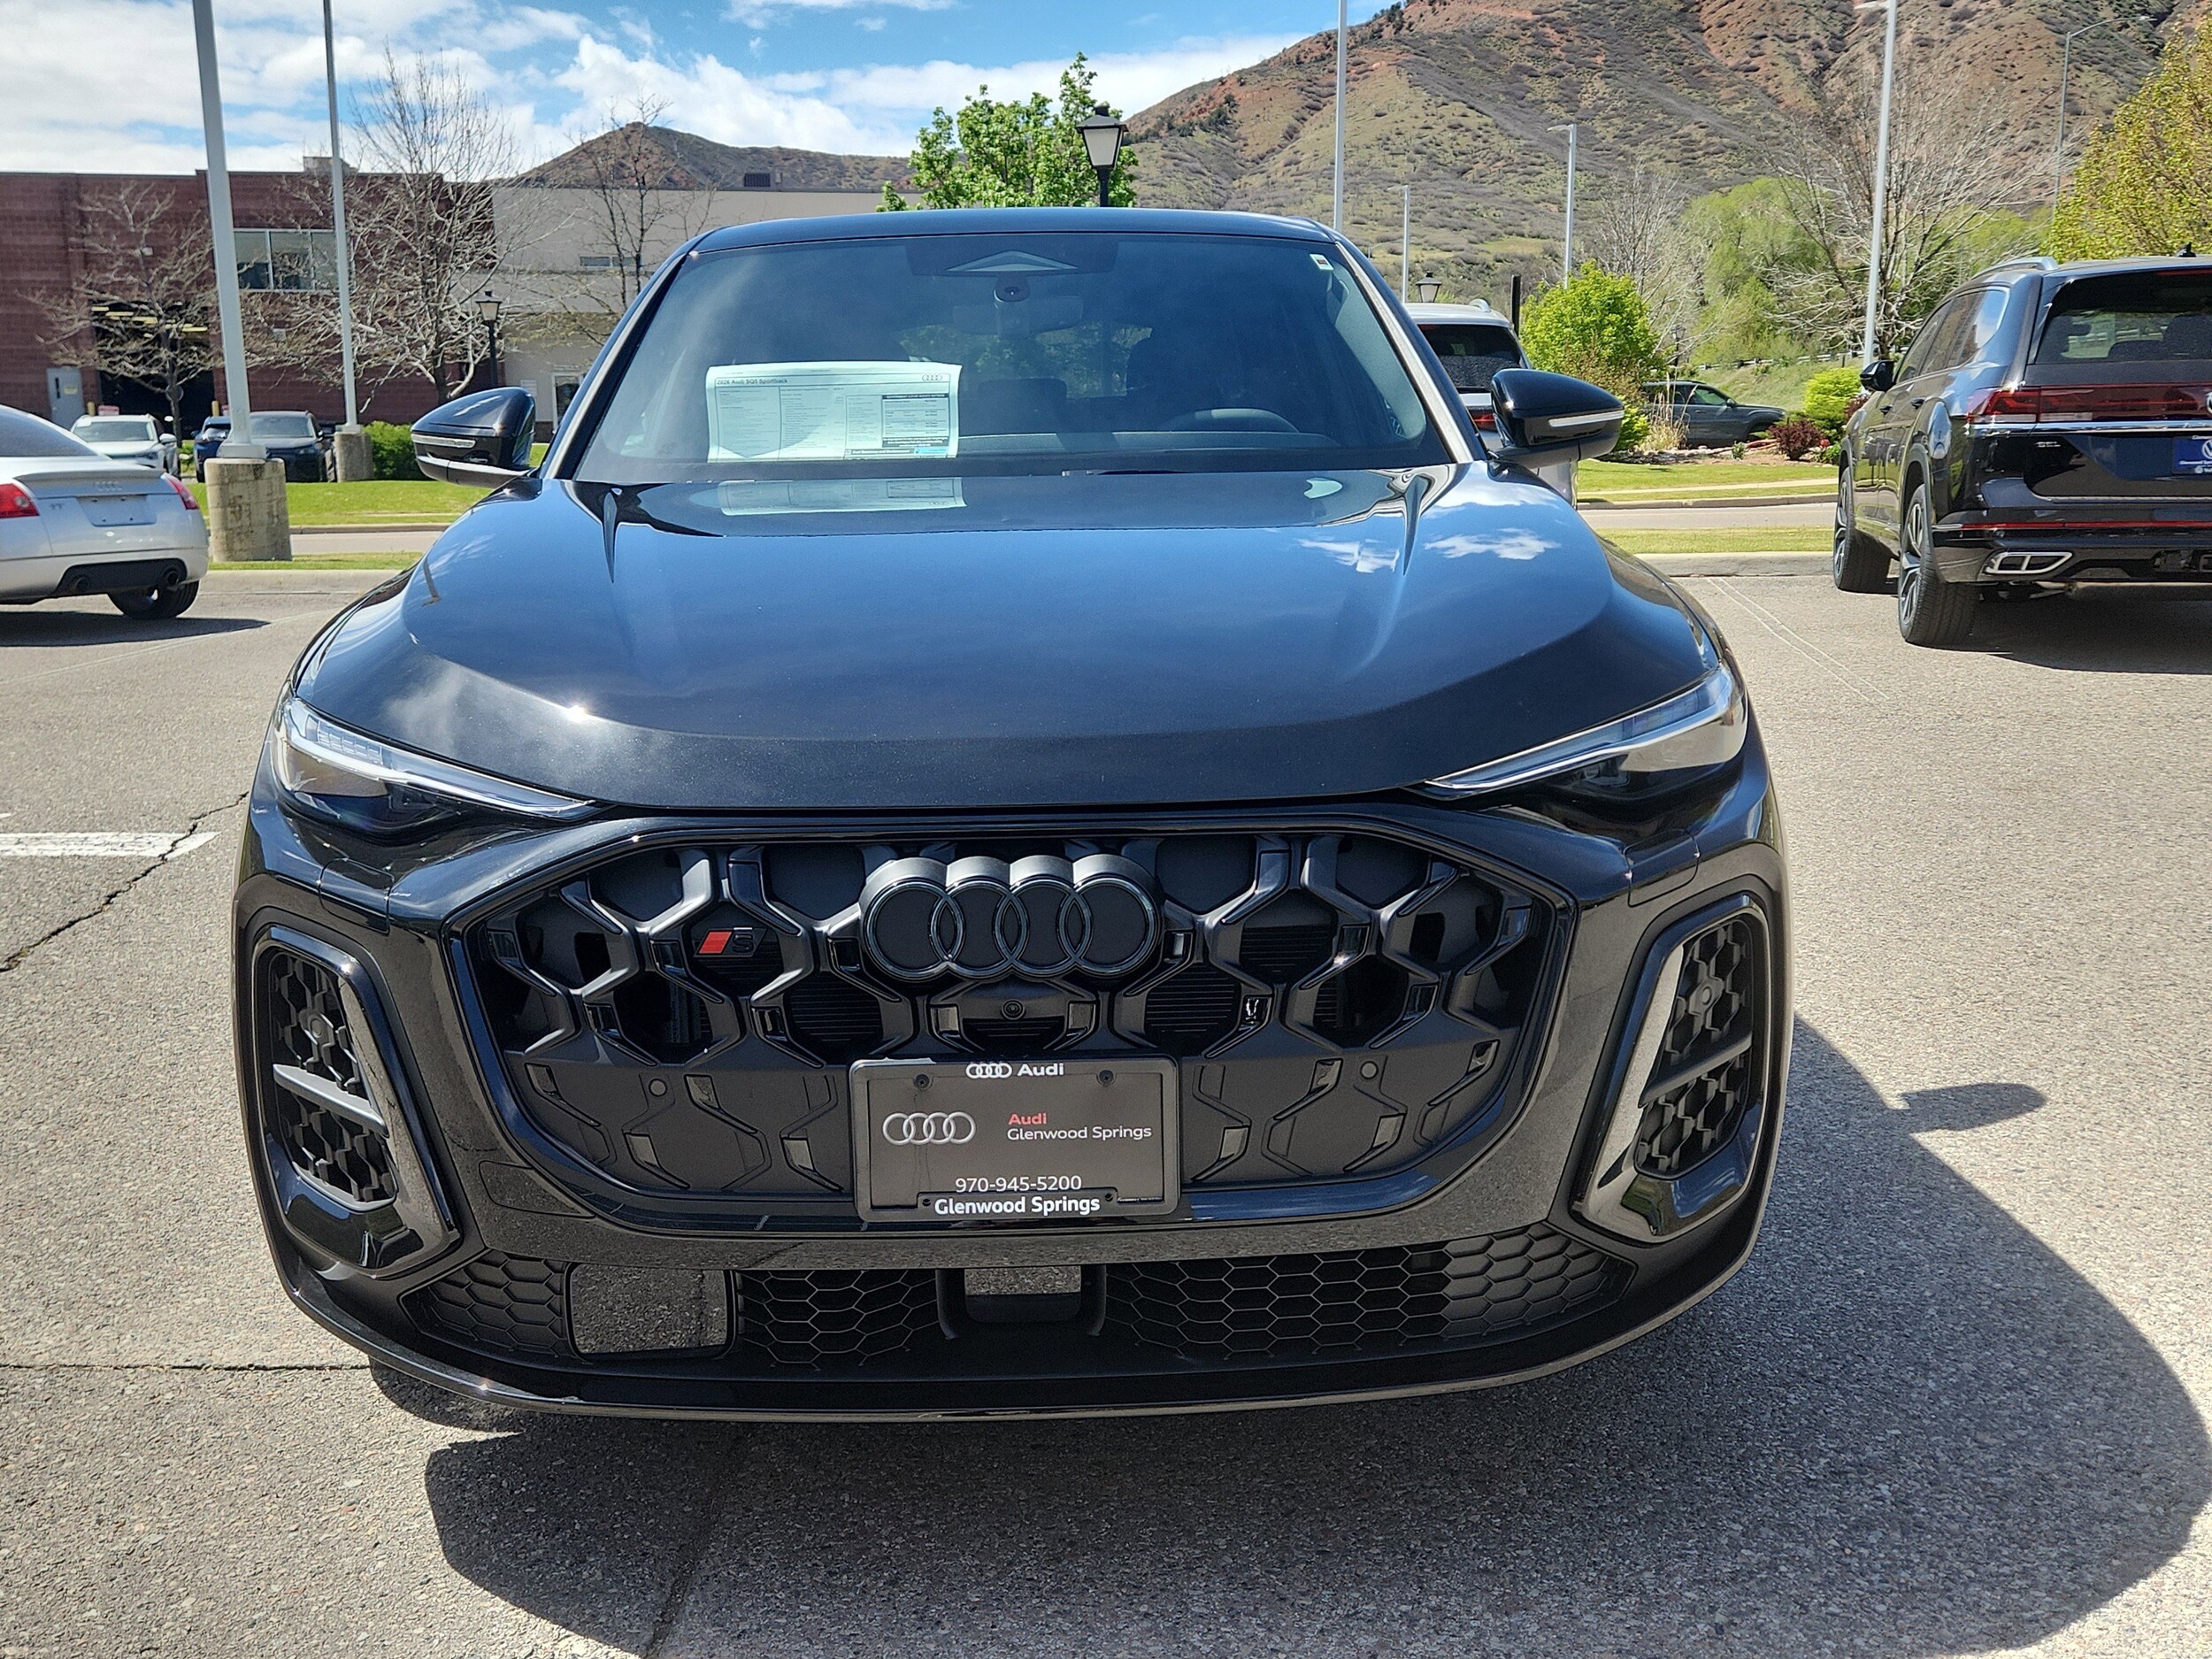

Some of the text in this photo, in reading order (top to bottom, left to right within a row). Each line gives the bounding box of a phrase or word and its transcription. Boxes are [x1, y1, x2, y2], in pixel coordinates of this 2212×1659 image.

[1017, 1063, 1064, 1076] Audi
[1008, 1113, 1048, 1125] Audi
[1007, 1125, 1152, 1141] Glenwood Springs
[955, 1175, 1082, 1193] 970-945-5200
[934, 1196, 1101, 1217] Glenwood Springs
